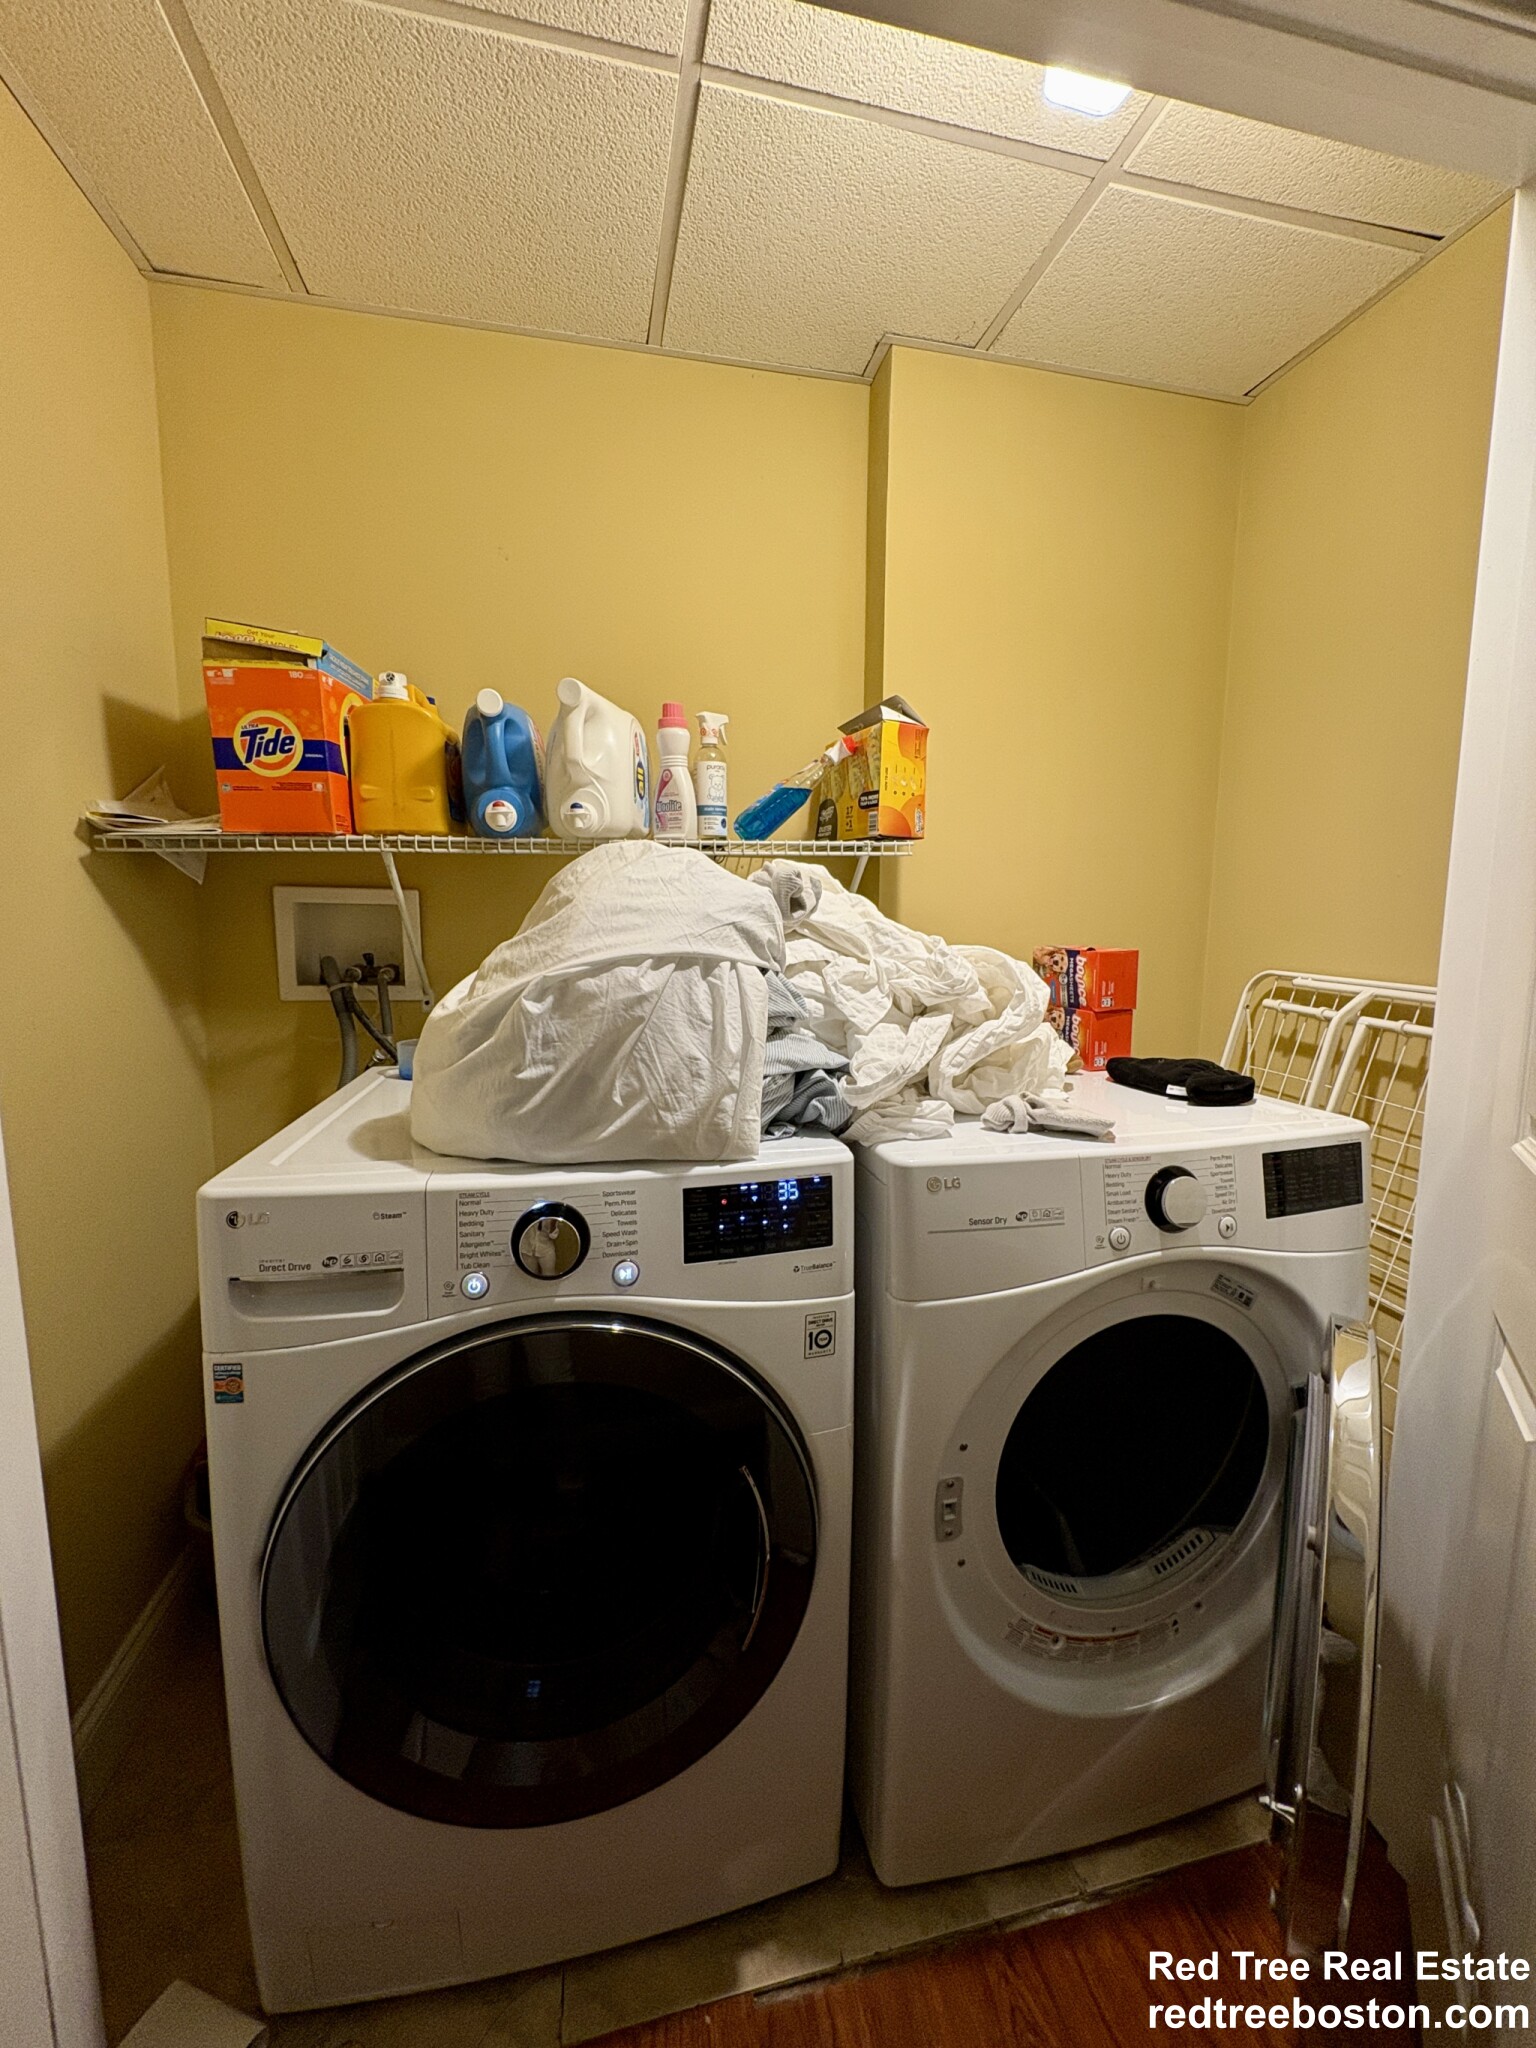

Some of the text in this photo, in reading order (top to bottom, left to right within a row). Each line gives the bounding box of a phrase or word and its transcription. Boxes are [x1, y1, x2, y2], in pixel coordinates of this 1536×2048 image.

[288, 670, 304, 678] 180
[240, 727, 296, 764] Tide
[656, 800, 682, 812] Woolite
[1076, 955, 1088, 1007] bounce
[1070, 1013, 1082, 1056] bounc
[944, 1176, 960, 1190] LG
[602, 1190, 636, 1198] Sportswear
[459, 1210, 478, 1218] Heavy
[459, 1220, 484, 1228] Bedding
[969, 1216, 1008, 1226] Sensor Dry
[460, 1252, 479, 1260] Bright
[602, 1249, 638, 1258] Downloaded
[259, 1262, 312, 1272] Direct Drive
[460, 1261, 490, 1270] Tub Clean
[808, 1329, 832, 1350] 10
